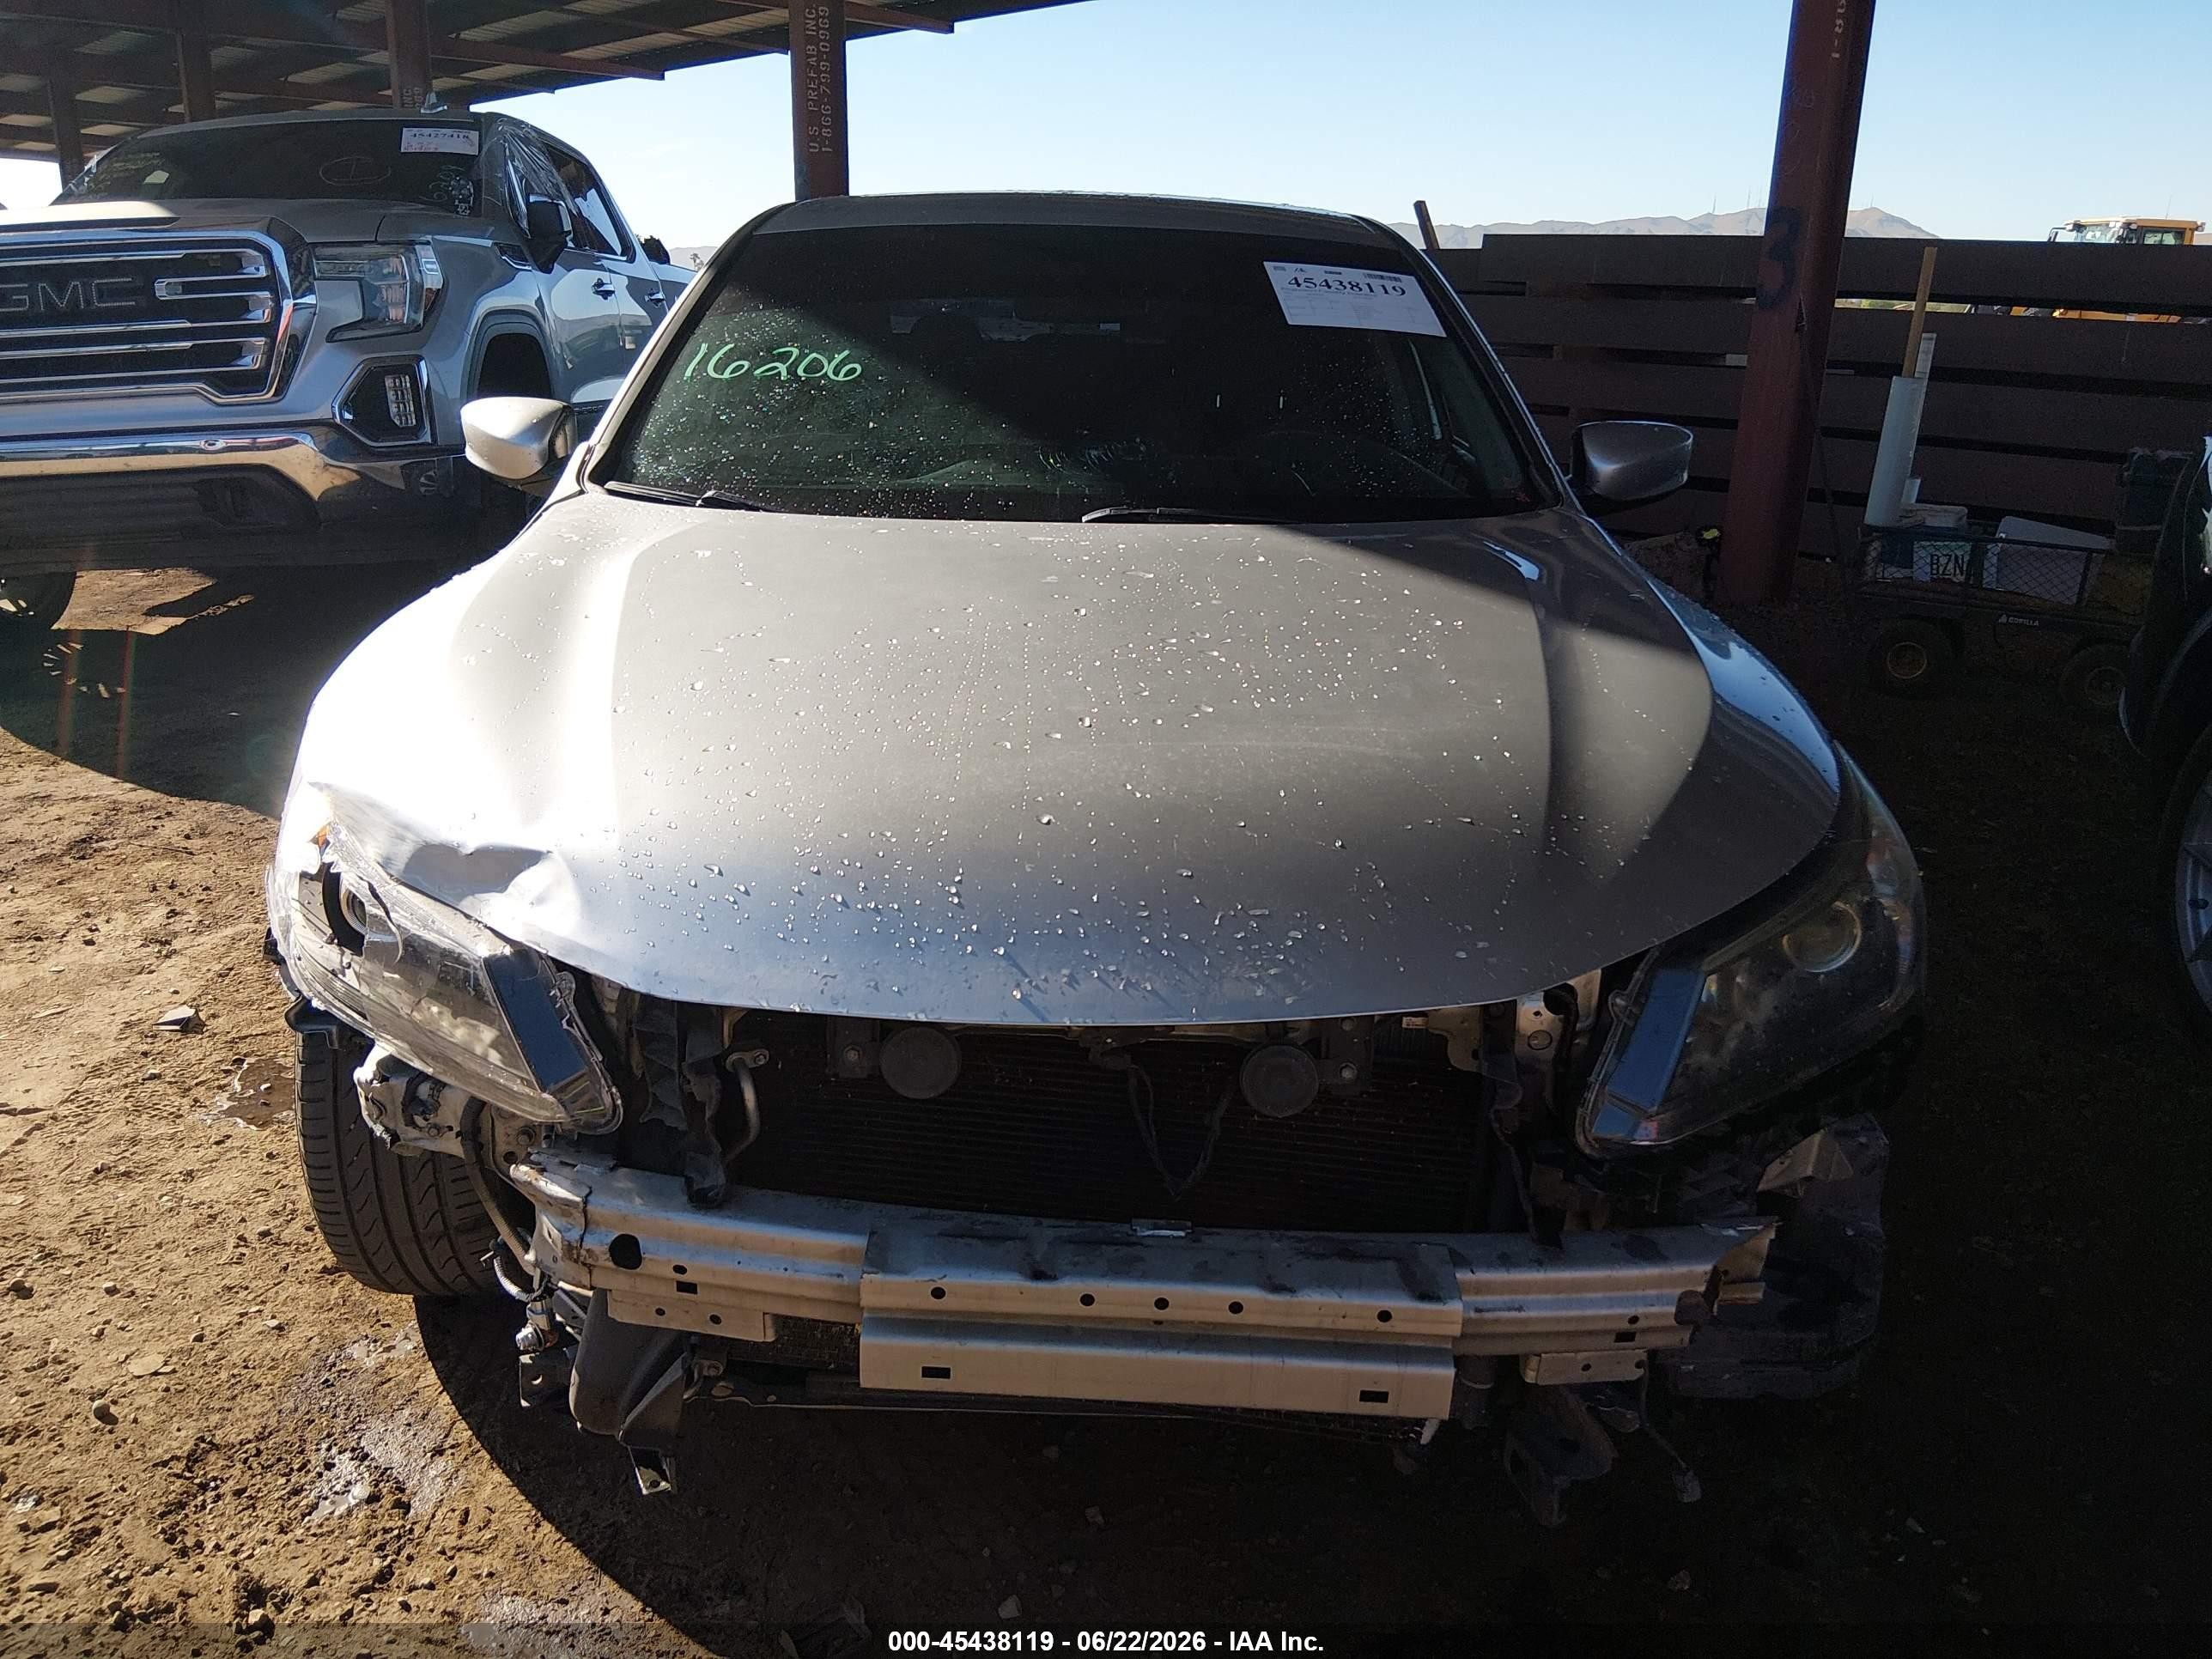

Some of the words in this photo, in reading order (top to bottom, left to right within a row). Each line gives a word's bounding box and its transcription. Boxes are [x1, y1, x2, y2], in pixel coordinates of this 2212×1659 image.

[806, 45, 818, 111] PREFAB
[0, 278, 136, 312] GMC
[1288, 276, 1406, 296] 45438119
[684, 343, 862, 380] 16206
